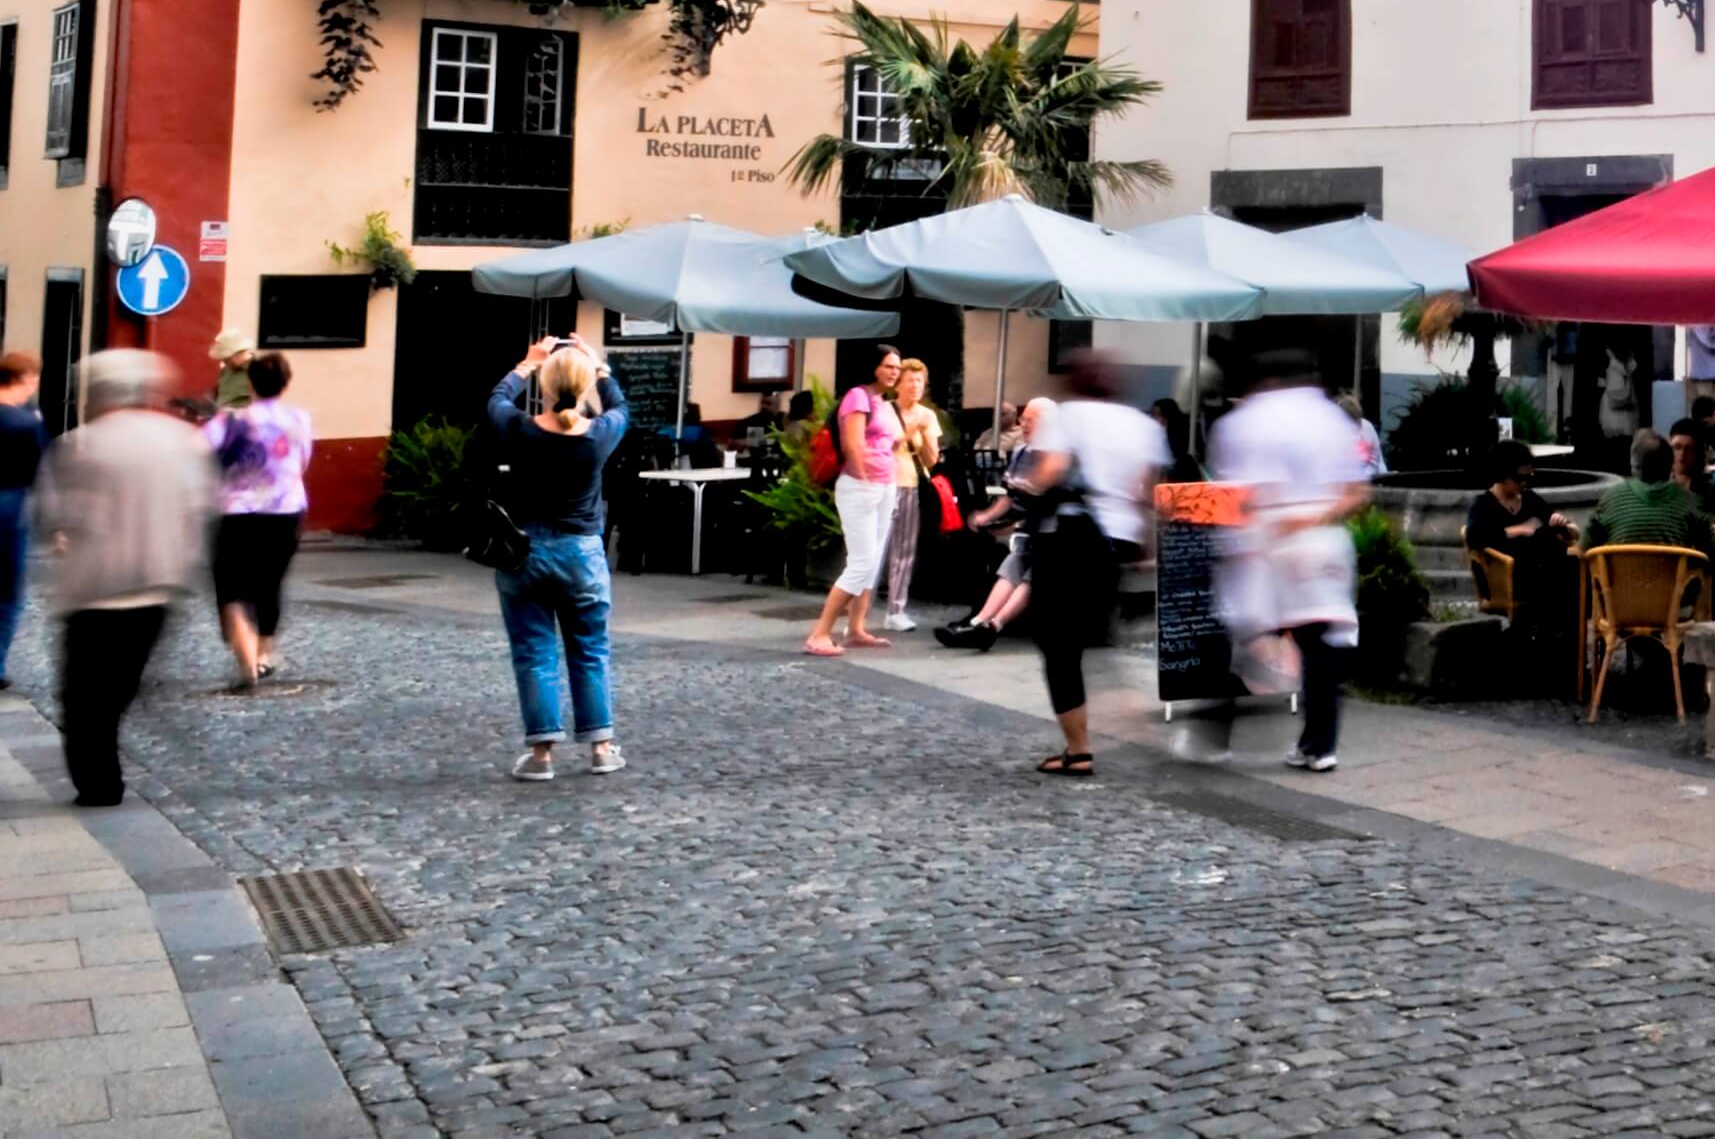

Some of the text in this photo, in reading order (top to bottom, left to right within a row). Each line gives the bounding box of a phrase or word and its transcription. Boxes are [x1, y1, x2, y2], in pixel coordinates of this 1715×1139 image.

[636, 107, 775, 138] LA PLACETA
[646, 138, 762, 161] Restaurante
[748, 170, 775, 183] Piso
